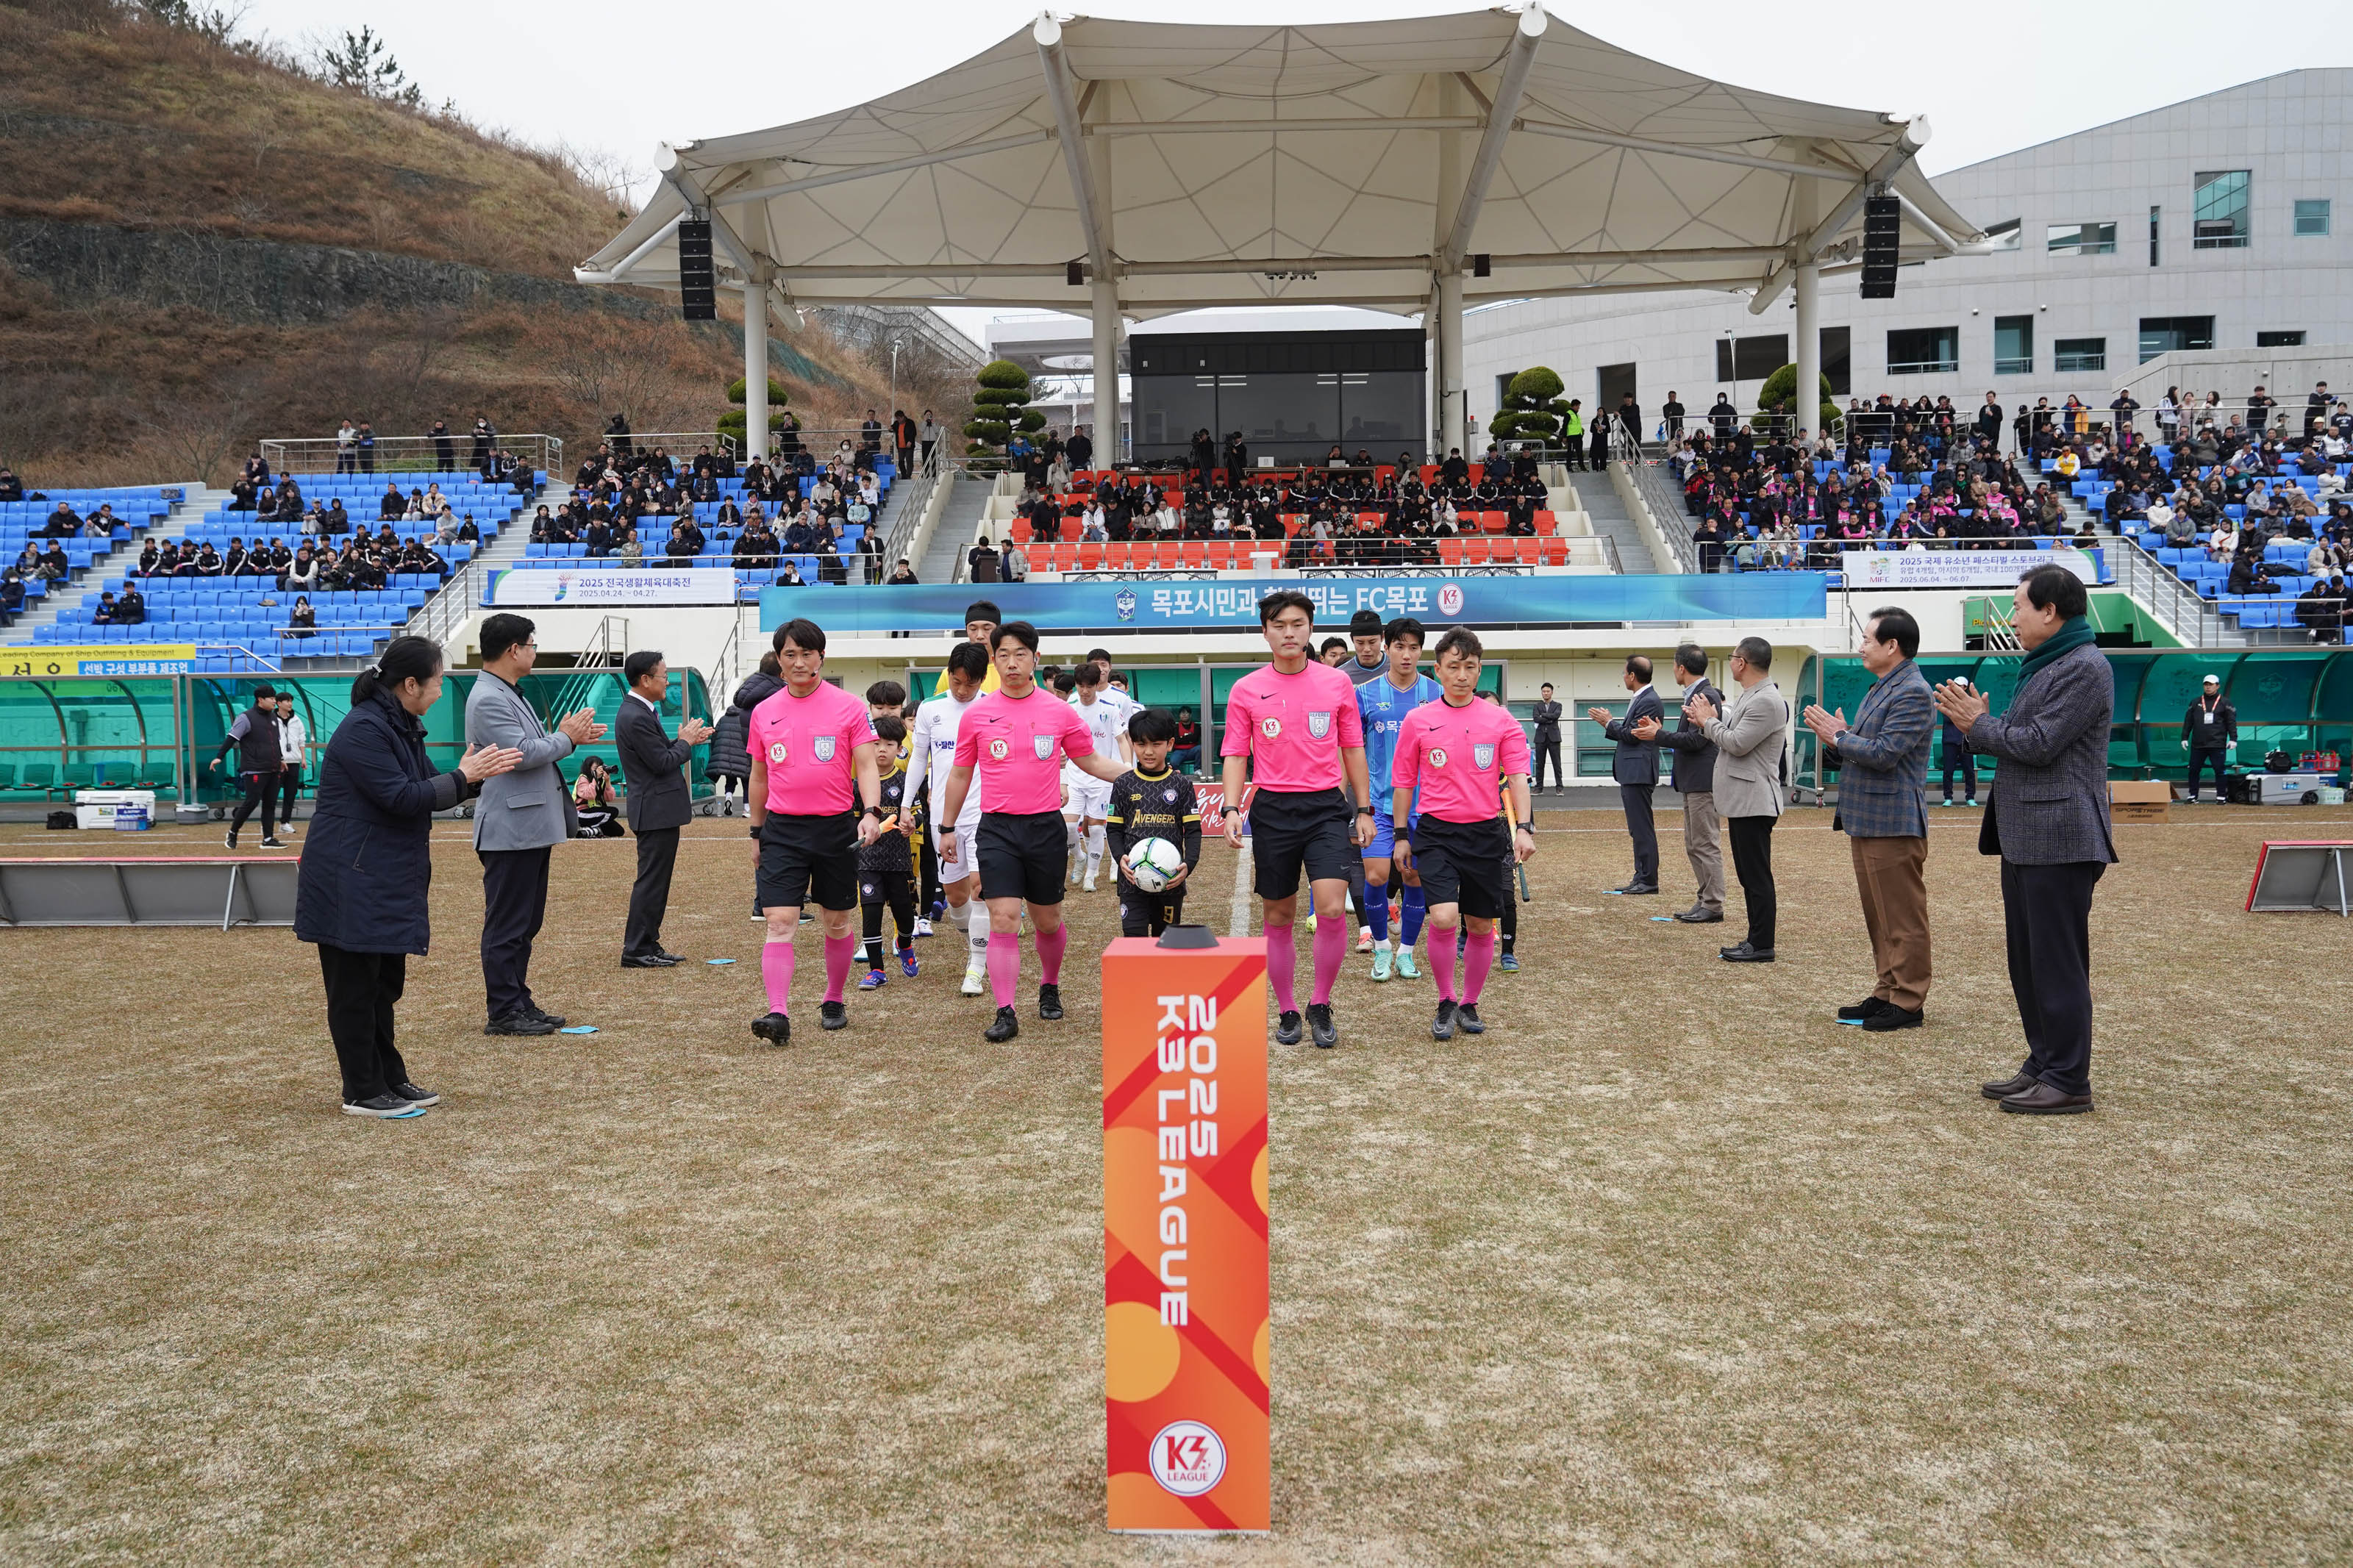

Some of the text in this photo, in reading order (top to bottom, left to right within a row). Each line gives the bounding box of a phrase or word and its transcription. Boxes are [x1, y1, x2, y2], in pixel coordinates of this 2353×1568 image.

[1899, 557, 1922, 565] 2025
[1924, 556, 1941, 565] 국제
[1945, 556, 1970, 565] 유소년
[1938, 566, 1960, 574] 아시아
[1985, 565, 1999, 573] 국내
[579, 579, 604, 587] 2025
[1151, 587, 1259, 617] 목포시민과
[1356, 586, 1429, 615] FC목포
[30, 650, 65, 659] Company
[136, 648, 175, 657] Equipment
[84, 662, 188, 675] 선박 구성 부분품 제조업
[1131, 809, 1176, 829] AVENGERS
[1188, 994, 1218, 1158] 2025
[1157, 994, 1188, 1326] K3 LEAGUE
[1167, 1472, 1210, 1482] LEAGUE
